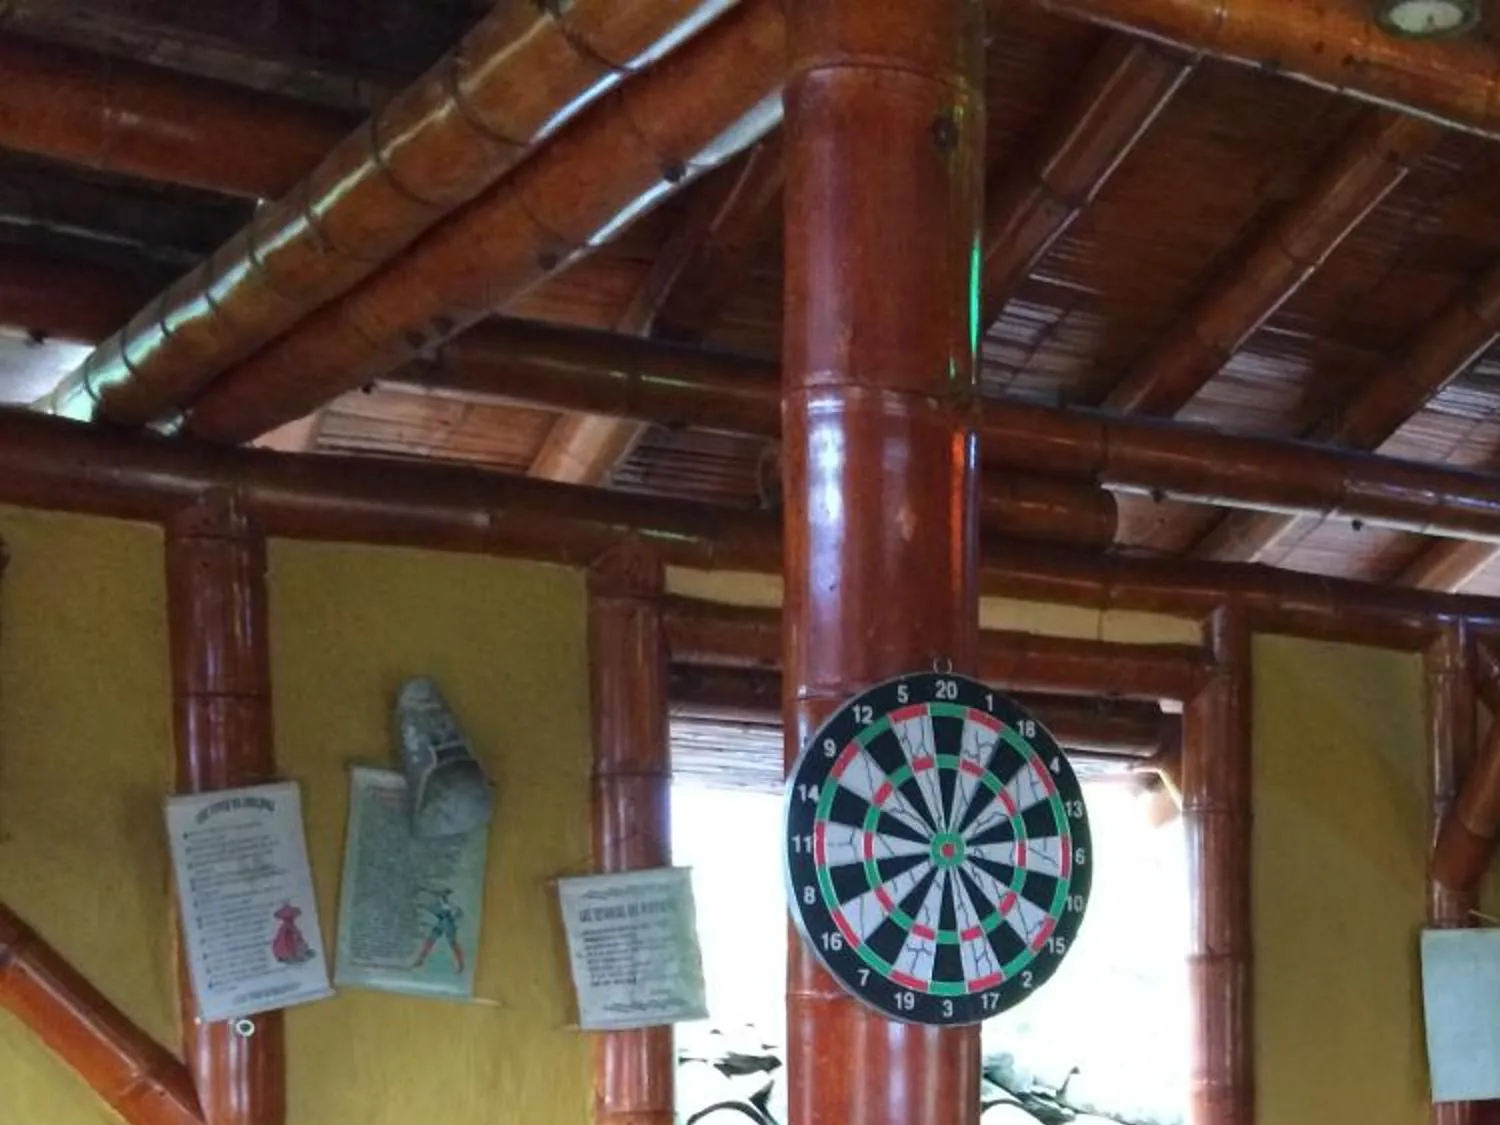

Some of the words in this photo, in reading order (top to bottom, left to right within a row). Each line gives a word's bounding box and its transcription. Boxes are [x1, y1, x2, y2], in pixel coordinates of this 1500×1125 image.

[898, 685, 908, 702] 5
[936, 681, 958, 698] 20
[853, 706, 873, 723] 12
[1017, 721, 1035, 738] 18
[823, 740, 837, 757] 9
[1051, 756, 1061, 772] 4
[801, 784, 818, 801] 14
[1066, 801, 1083, 817] 13
[792, 836, 813, 853] 11
[1075, 849, 1085, 864] 6
[803, 887, 815, 903] 8
[1065, 896, 1083, 912] 10
[822, 933, 842, 950] 16
[1049, 937, 1064, 953] 15
[858, 968, 871, 985] 7
[1022, 972, 1033, 988] 2
[896, 992, 915, 1009] 19
[943, 1000, 953, 1017] 3
[981, 993, 999, 1009] 17
